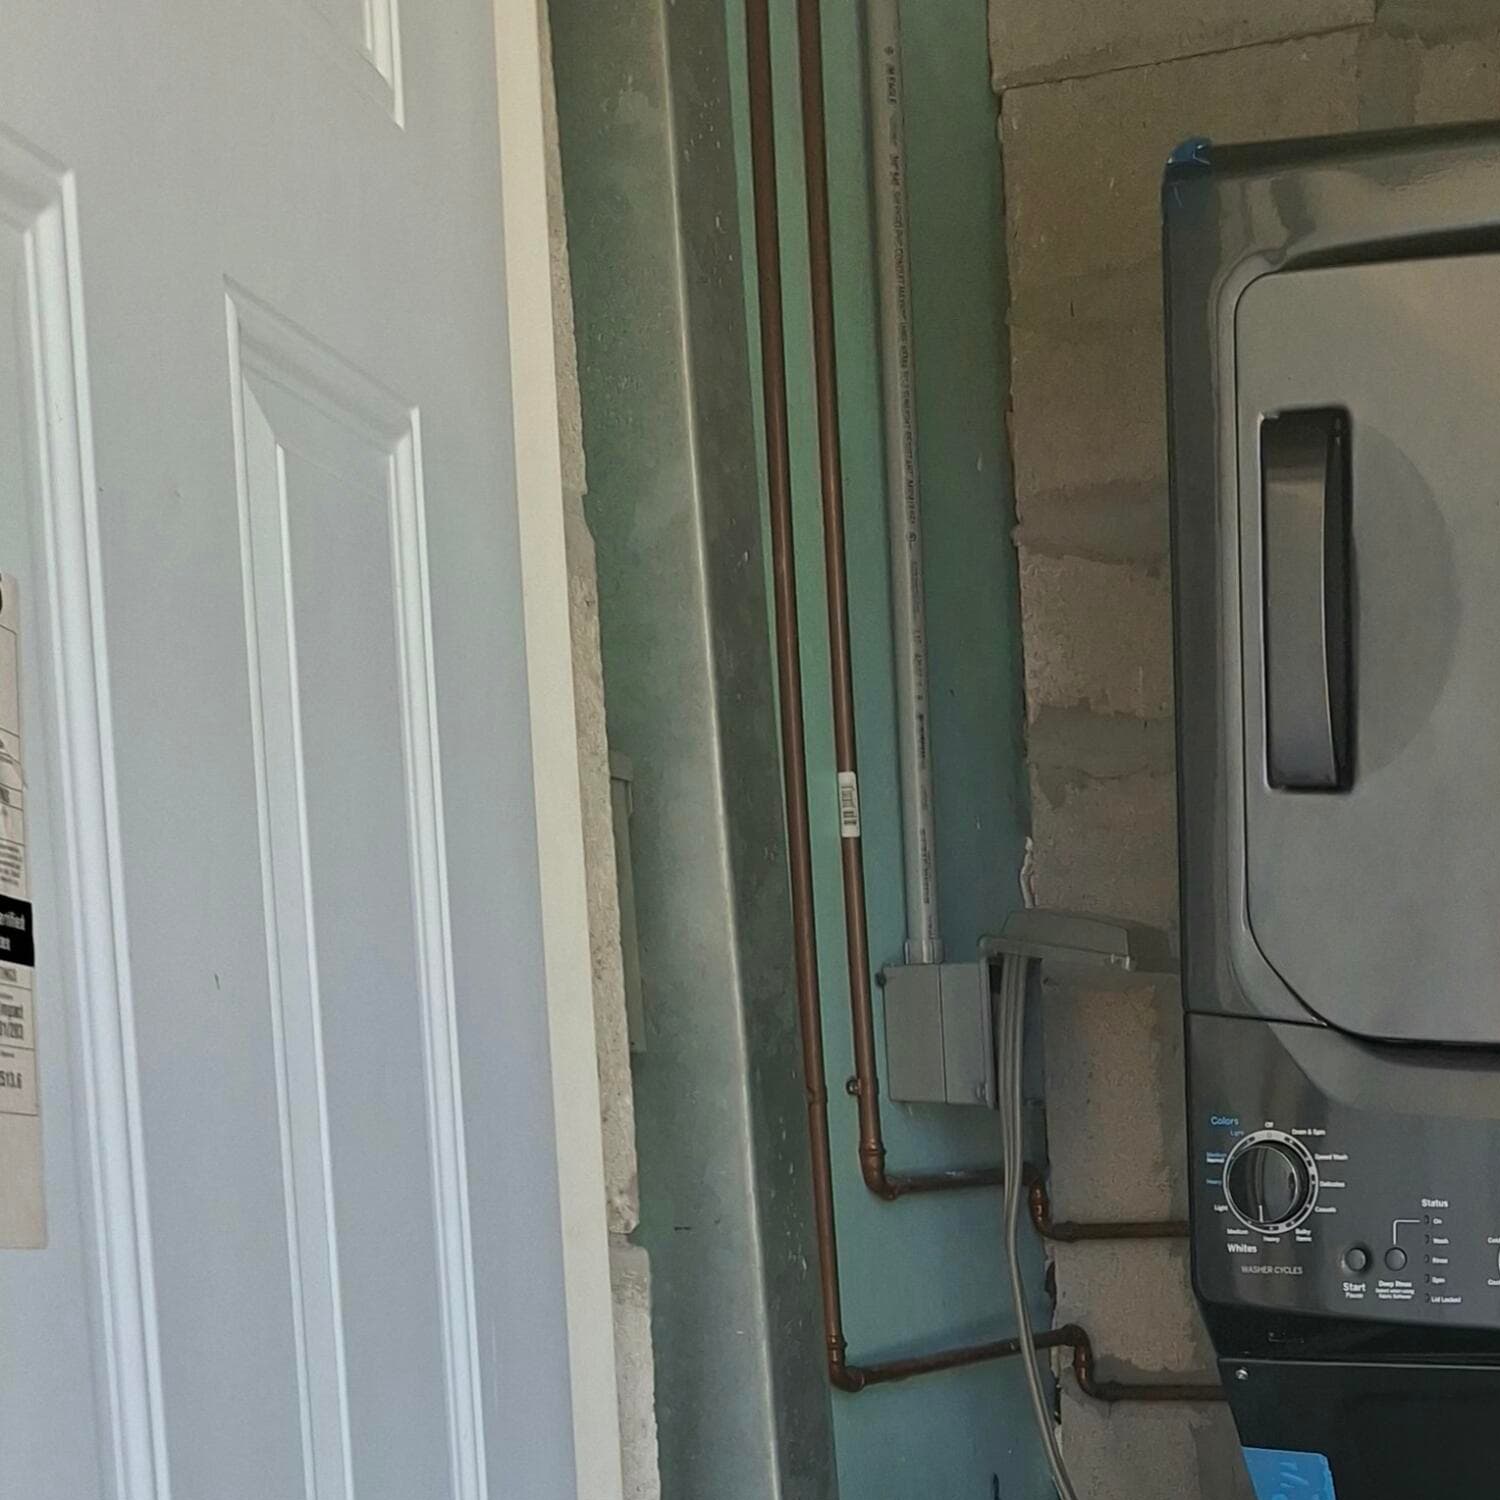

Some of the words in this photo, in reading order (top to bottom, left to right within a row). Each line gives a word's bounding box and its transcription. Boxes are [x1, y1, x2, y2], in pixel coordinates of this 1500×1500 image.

[1211, 1116, 1238, 1126] Colors
[1422, 1199, 1448, 1208] Status
[1227, 1244, 1257, 1253] Whites
[1241, 1266, 1273, 1274] WASHER
[1276, 1266, 1303, 1274] CYCLES
[1343, 1282, 1366, 1292] Start
[1441, 1296, 1461, 1304] Locked
